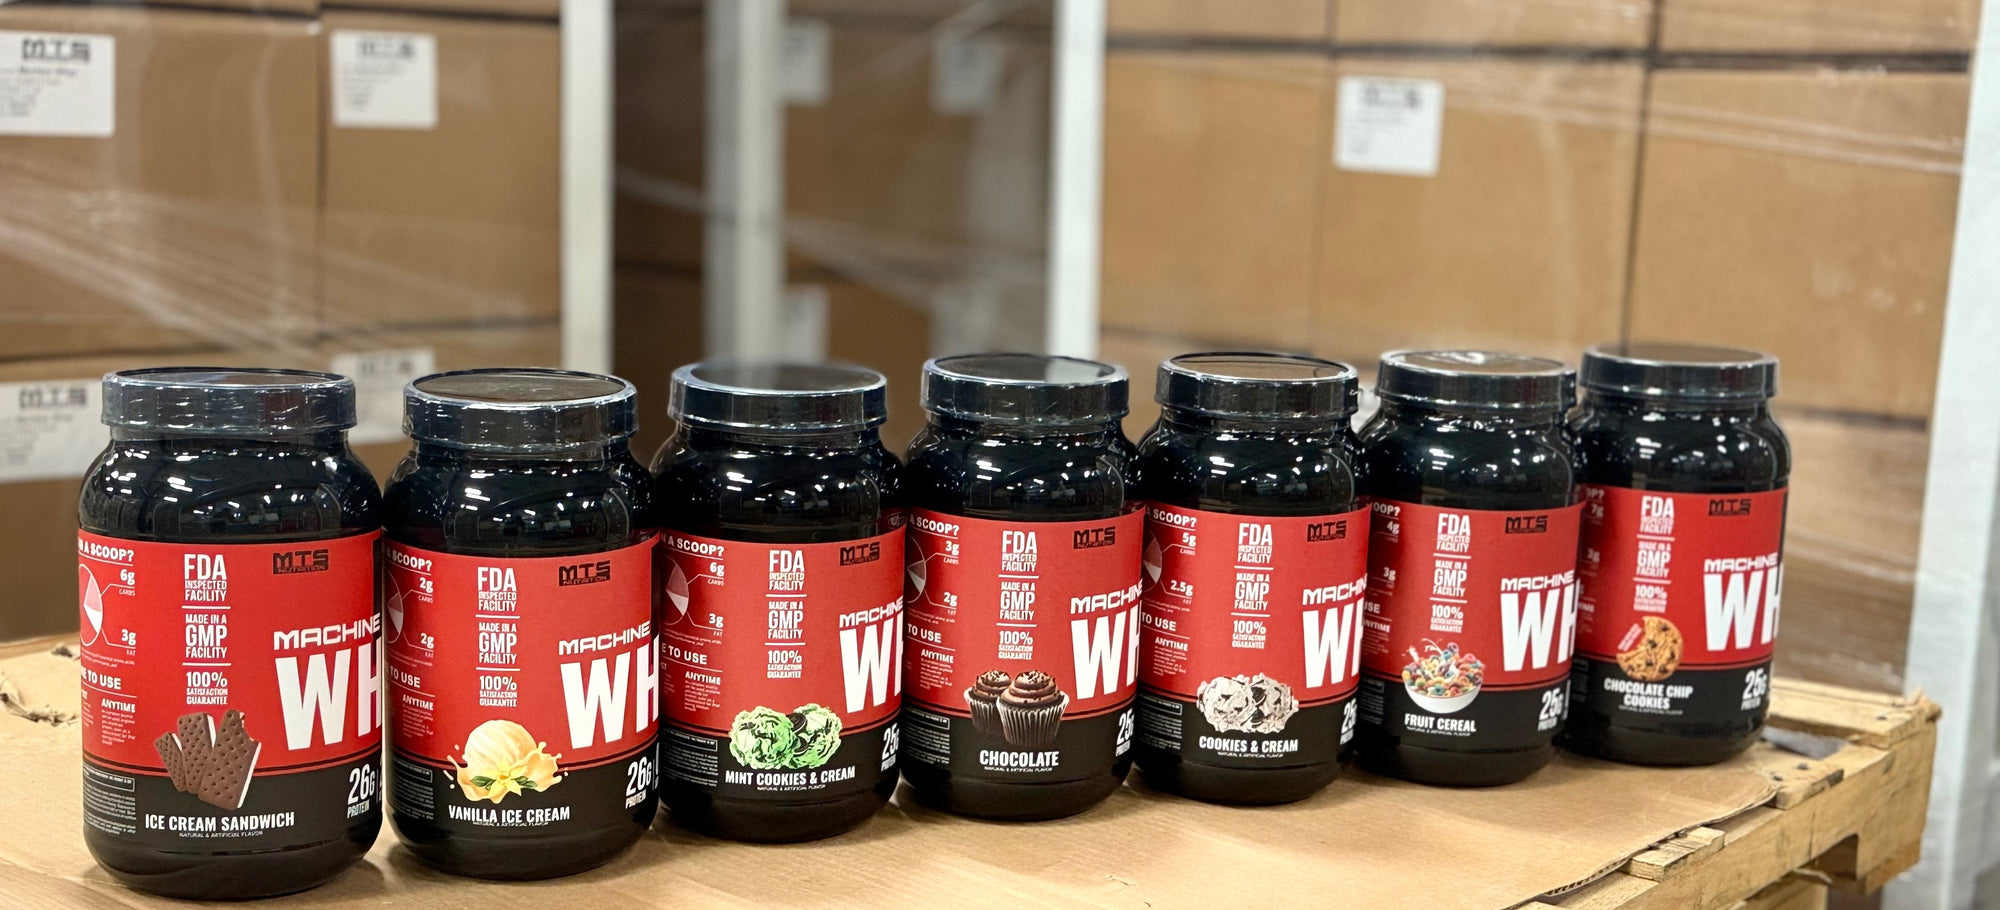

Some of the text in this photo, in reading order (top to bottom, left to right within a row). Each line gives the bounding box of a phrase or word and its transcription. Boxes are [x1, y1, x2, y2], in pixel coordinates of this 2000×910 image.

[1641, 495, 1674, 518] FDA
[916, 517, 960, 536] SCOOP?
[1153, 509, 1197, 528] SCOOP?
[1437, 512, 1471, 536] FDA
[1505, 515, 1548, 532] MTS
[1238, 522, 1273, 546] FDA
[1307, 520, 1347, 540] MTS
[1386, 520, 1400, 535] 4g
[1002, 530, 1038, 554] FDA
[1073, 526, 1116, 547] MTS
[1182, 532, 1196, 547] 5g
[90, 542, 134, 562] SCOOP?
[668, 536, 674, 547] A
[676, 538, 725, 557] SCOOP?
[839, 542, 880, 563] MTS
[945, 540, 960, 556] 3g
[1436, 541, 1469, 553] FACILITY
[273, 549, 329, 571] MTS
[392, 551, 432, 571] SCOOP?
[769, 550, 805, 573] FDA
[1001, 561, 1037, 572] FACILITY
[1237, 552, 1272, 564] FACILITY
[1636, 549, 1671, 569] GMP
[1704, 552, 1779, 574] MACHINE
[183, 554, 227, 580] FDA
[559, 560, 611, 583] MTS
[709, 562, 725, 577] 6g
[1383, 566, 1396, 581] 3g
[120, 569, 136, 585] 6g
[184, 580, 227, 589] INSPECTED
[419, 577, 434, 593] 2g
[477, 566, 517, 592] FDA
[768, 580, 804, 591] FACILITY
[1264, 574, 1270, 582] A
[1433, 569, 1467, 588] GMP
[1500, 569, 1574, 591] MACHINE
[1000, 581, 1020, 591] MADE
[1030, 582, 1036, 591] A
[1170, 580, 1193, 597] 2.5g
[1235, 581, 1270, 601] GMP
[1432, 585, 1466, 597] FACILITY
[1634, 584, 1668, 600] 100%
[184, 590, 227, 602] FACILITY
[944, 592, 958, 607] 2g
[1000, 591, 1036, 611] GMP
[478, 600, 517, 612] FACILITY
[768, 601, 788, 610] MADE
[798, 601, 804, 610] A
[1234, 600, 1268, 611] FACILITY
[1432, 604, 1464, 619] 100%
[1703, 562, 1784, 652] WH
[185, 614, 227, 624] MADE IN A
[709, 613, 724, 628] 3g
[768, 610, 804, 629] GMP
[999, 610, 1035, 621] FACILITY
[1141, 612, 1176, 632] TO USE
[273, 613, 380, 650] MACHINE
[478, 622, 500, 632] MADE
[511, 622, 517, 633] A
[1233, 620, 1266, 634] 100%
[1500, 577, 1581, 672] WH
[121, 629, 137, 646] 3g
[185, 625, 228, 647] GMP
[420, 632, 434, 650] 2g
[558, 620, 651, 655] MACHINE
[768, 629, 803, 639] FACILITY
[907, 623, 942, 644] TO USE
[999, 630, 1033, 645] 100%
[478, 632, 517, 654] GMP
[185, 647, 228, 659] FACILITY
[478, 653, 517, 665] FACILITY
[668, 645, 708, 665] TO USE
[767, 650, 802, 664] 100%
[920, 649, 954, 664] ANYTIME
[87, 669, 98, 684] TO
[99, 673, 122, 690] USE
[186, 671, 228, 687] 100%
[389, 665, 421, 689] TO USE
[479, 675, 518, 691] 100%
[685, 671, 721, 685] ANYTIME
[1742, 667, 1768, 700] 25G
[1603, 678, 1694, 699] CHOCOLATE CHIP
[101, 698, 136, 713] ANYTIME
[186, 696, 228, 705] GUARANTEE
[402, 694, 434, 711] ANYTIME
[1623, 694, 1670, 710] COOKIES
[1404, 713, 1434, 729] FRUIT
[1436, 717, 1477, 732] CEREAL
[1199, 736, 1299, 753] COOKIES & CREAM
[979, 750, 1060, 767] CHOCOLATE
[347, 763, 376, 805] 26G
[626, 756, 652, 797] 26G
[725, 766, 856, 786] MINT COOKIES & CREAM
[145, 812, 295, 832] ICE CREAM SANDWICH
[448, 804, 570, 823] VANILLA ICE CREAM
